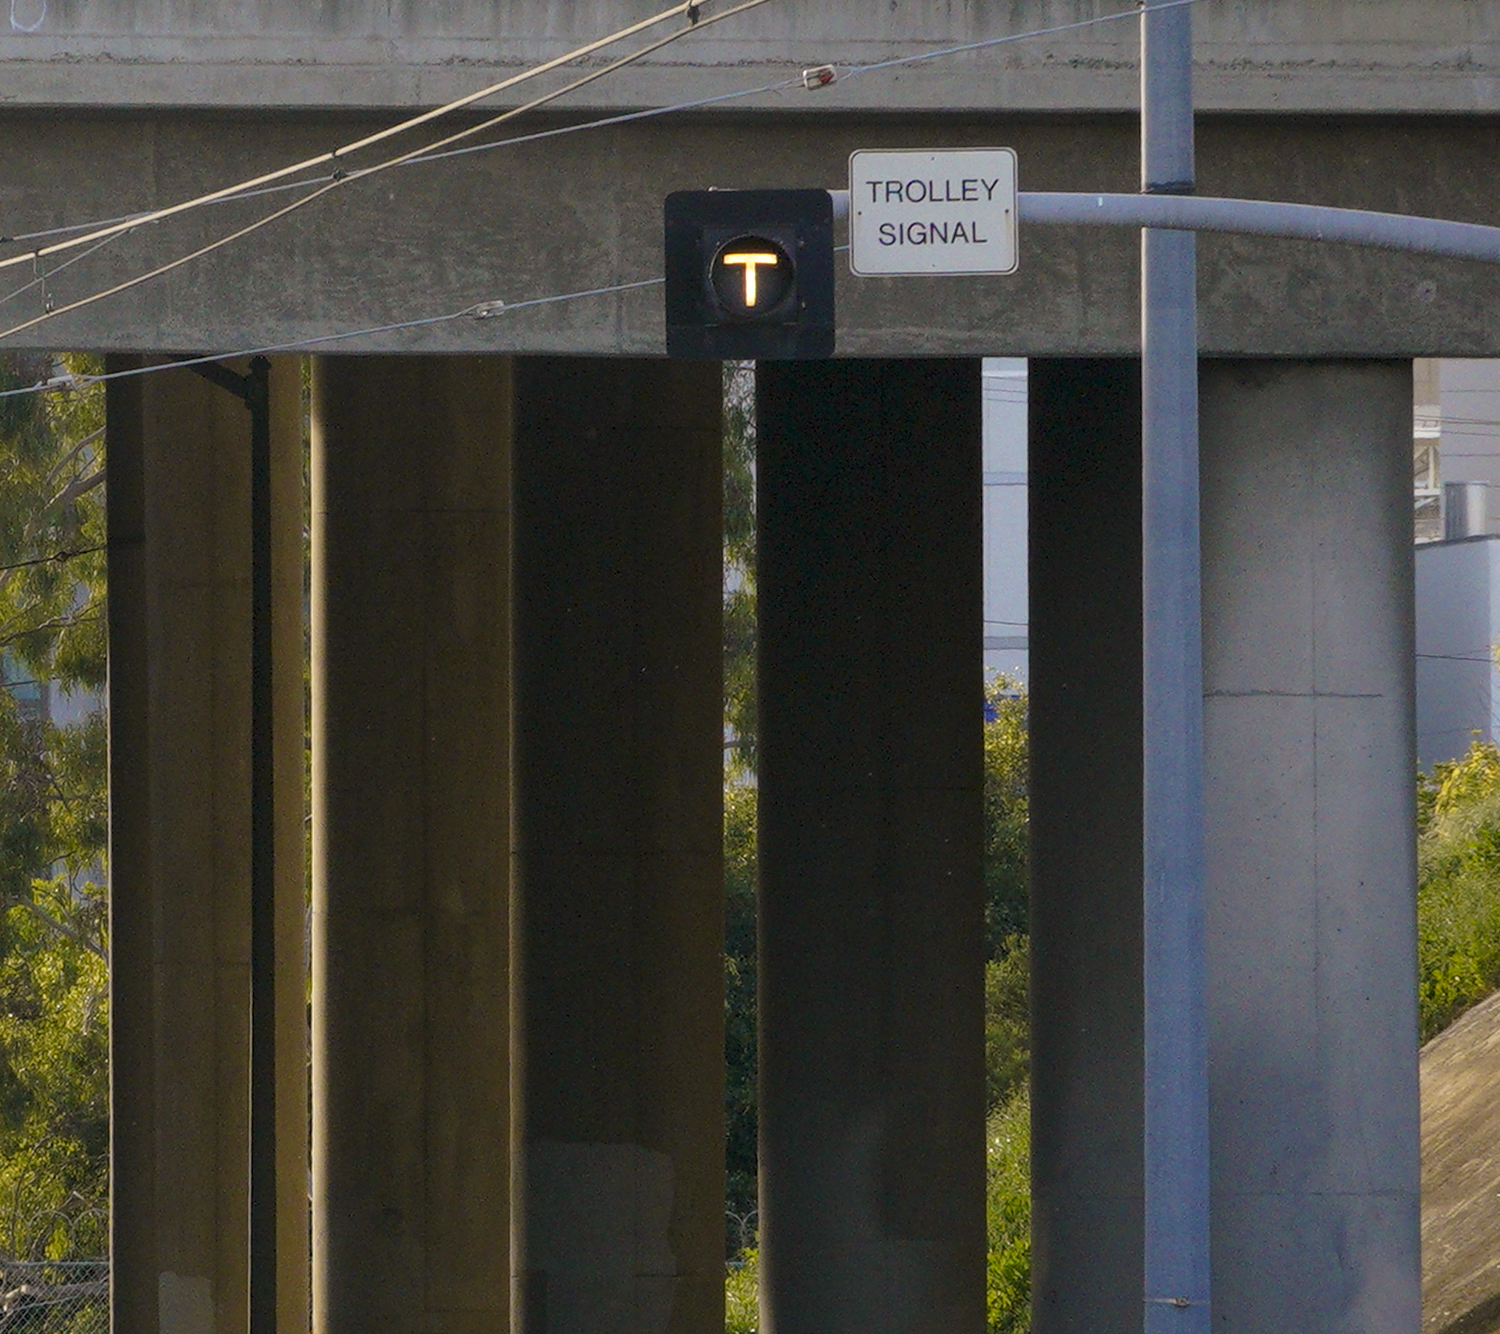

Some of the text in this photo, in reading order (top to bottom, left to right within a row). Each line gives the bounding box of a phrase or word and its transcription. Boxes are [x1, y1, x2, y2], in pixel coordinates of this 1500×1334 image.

[865, 178, 1000, 205] TROLLEY
[877, 220, 988, 247] SIGNAL
[723, 252, 778, 307] T
